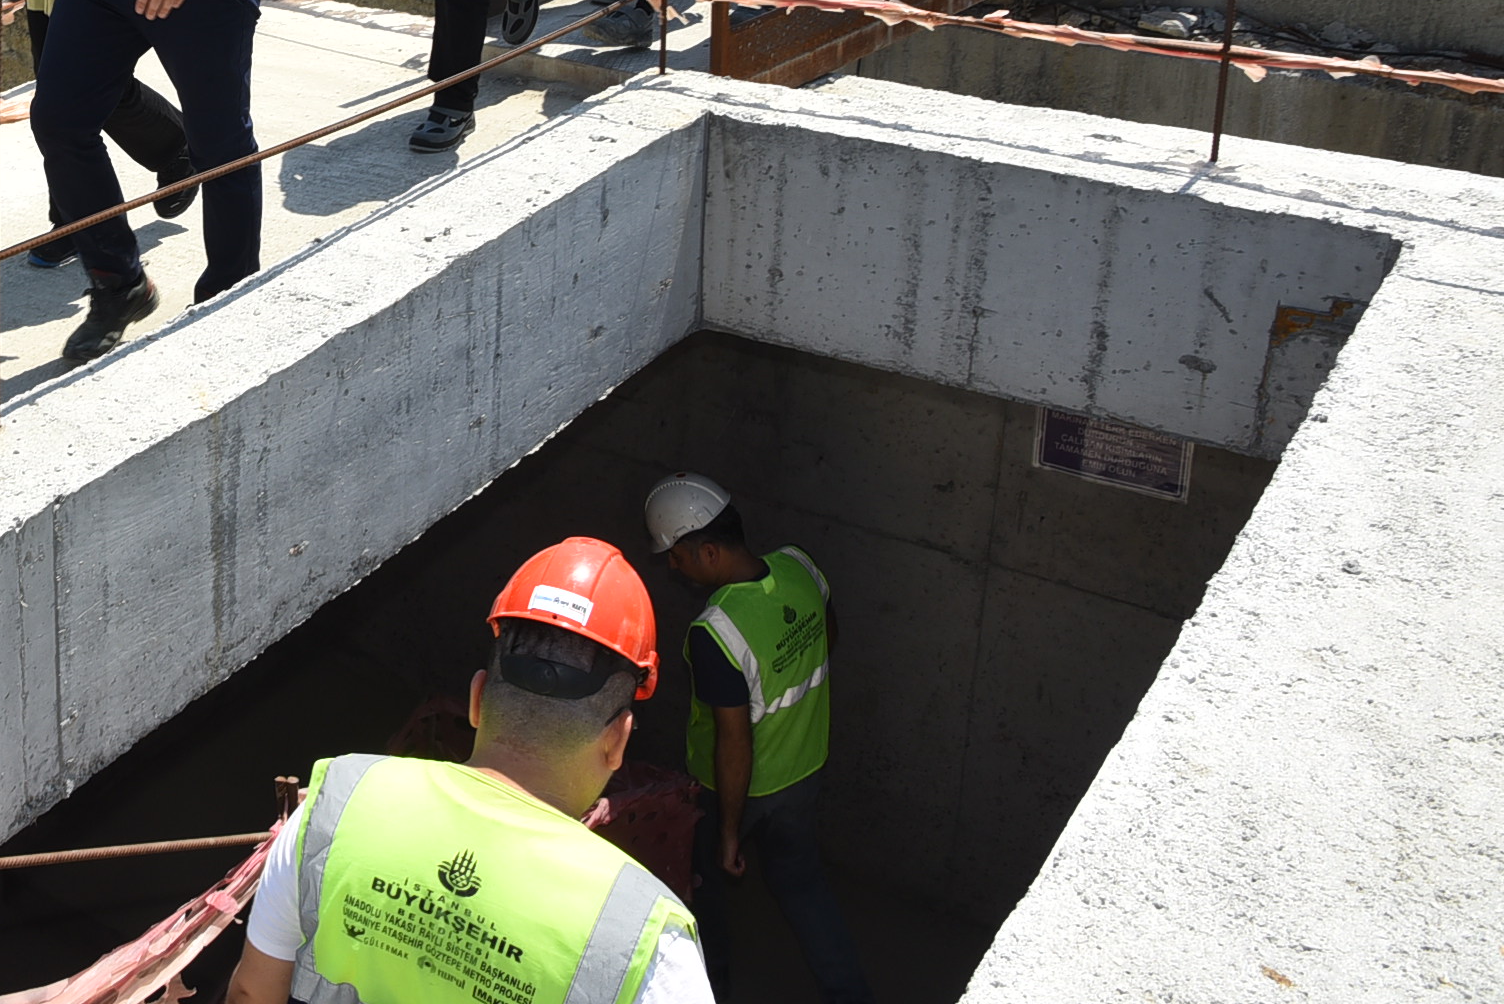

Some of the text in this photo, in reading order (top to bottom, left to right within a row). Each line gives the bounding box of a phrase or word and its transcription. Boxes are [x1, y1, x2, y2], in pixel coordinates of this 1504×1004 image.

[344, 894, 537, 997] ANADOLU YAKASI RAYLI SİSTEM BAŞKANLIĞI
[371, 876, 524, 964] BÜYÜKŞEHİR
[363, 936, 409, 960] GÜLERMAK
[478, 987, 510, 1004] MAK
[425, 943, 463, 971] GÖZTEPE
[462, 965, 493, 989] METRO
